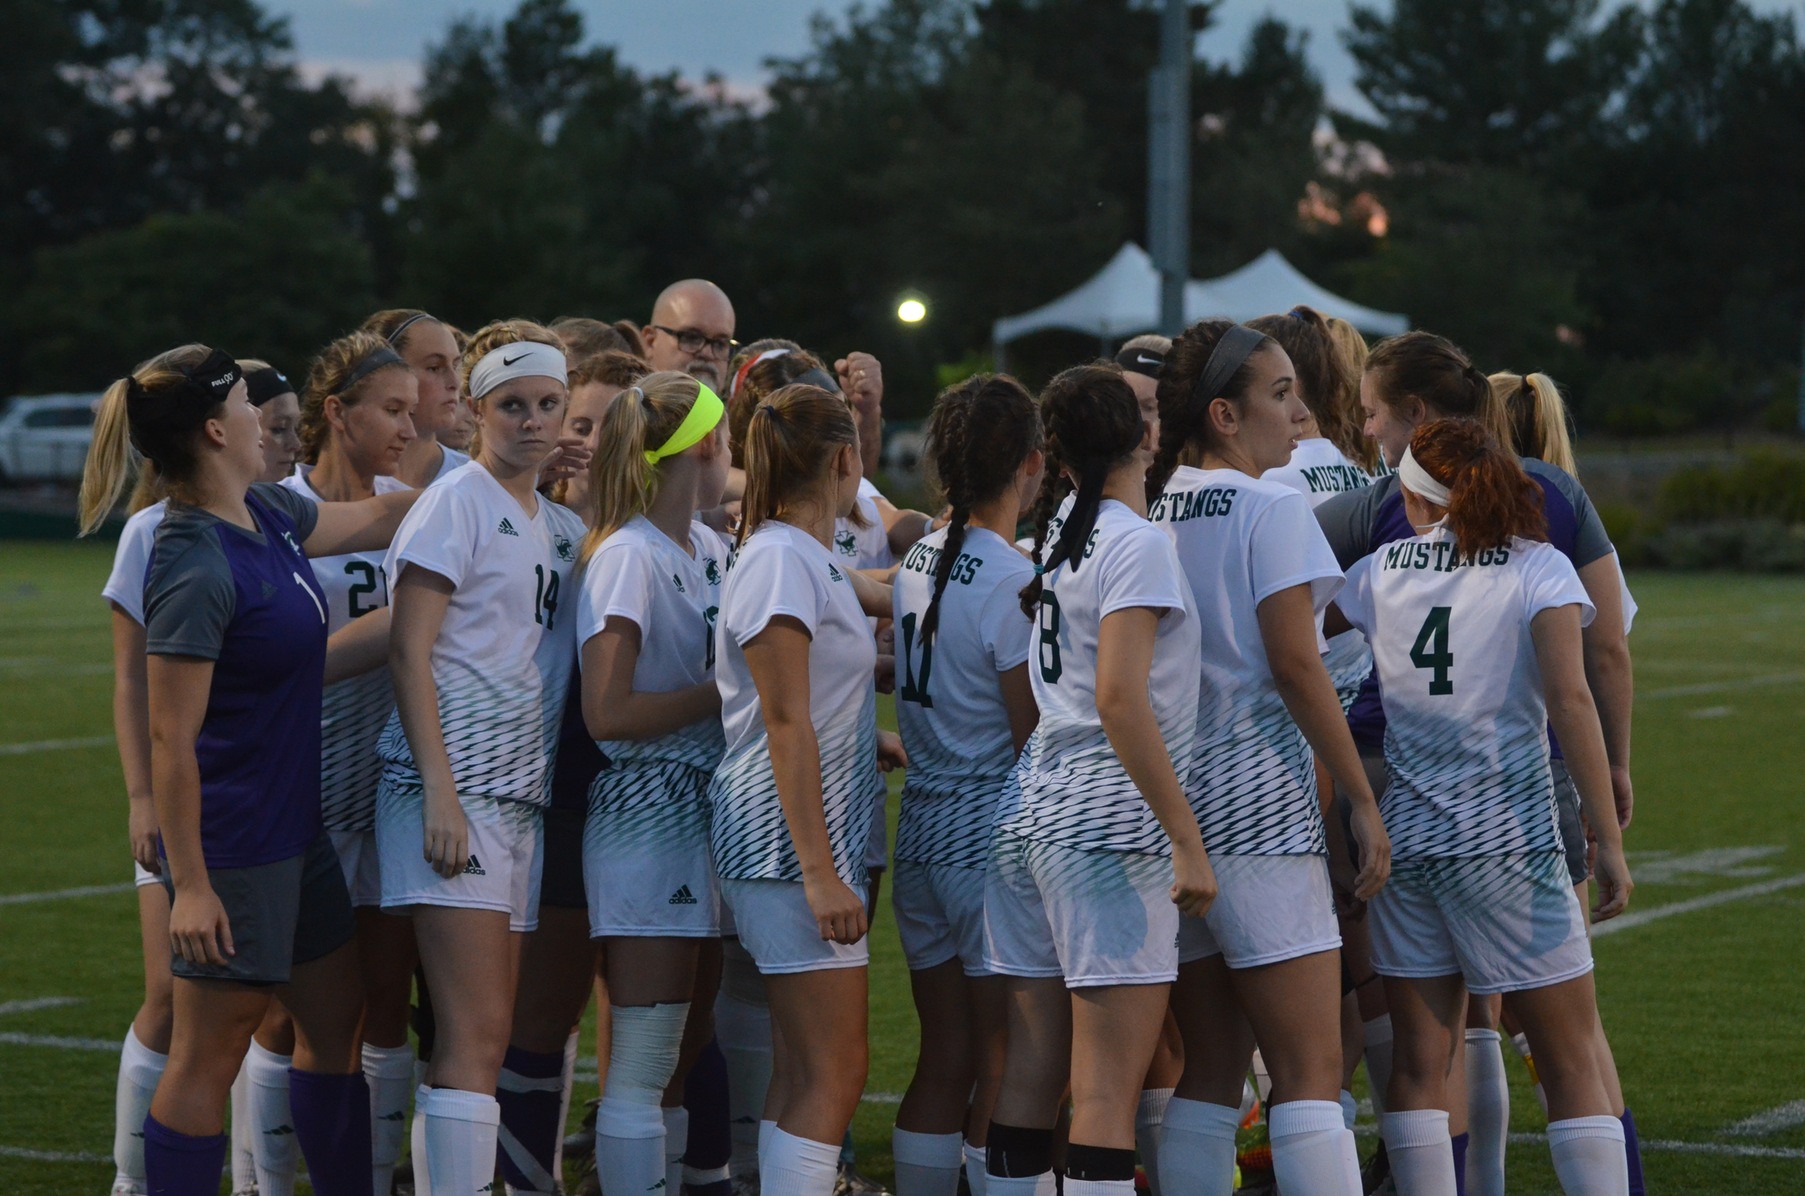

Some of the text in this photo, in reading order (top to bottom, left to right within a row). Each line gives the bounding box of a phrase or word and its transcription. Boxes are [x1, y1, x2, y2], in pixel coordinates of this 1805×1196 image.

[1299, 465, 1371, 493] MUSTANG
[1147, 488, 1237, 523] USTANGS
[900, 541, 983, 585] USTGS
[294, 573, 326, 625] 1
[535, 563, 560, 631] 14
[1038, 589, 1062, 684] 8
[1410, 606, 1454, 696] 4
[462, 865, 486, 876] didas
[668, 896, 698, 905] adidas
